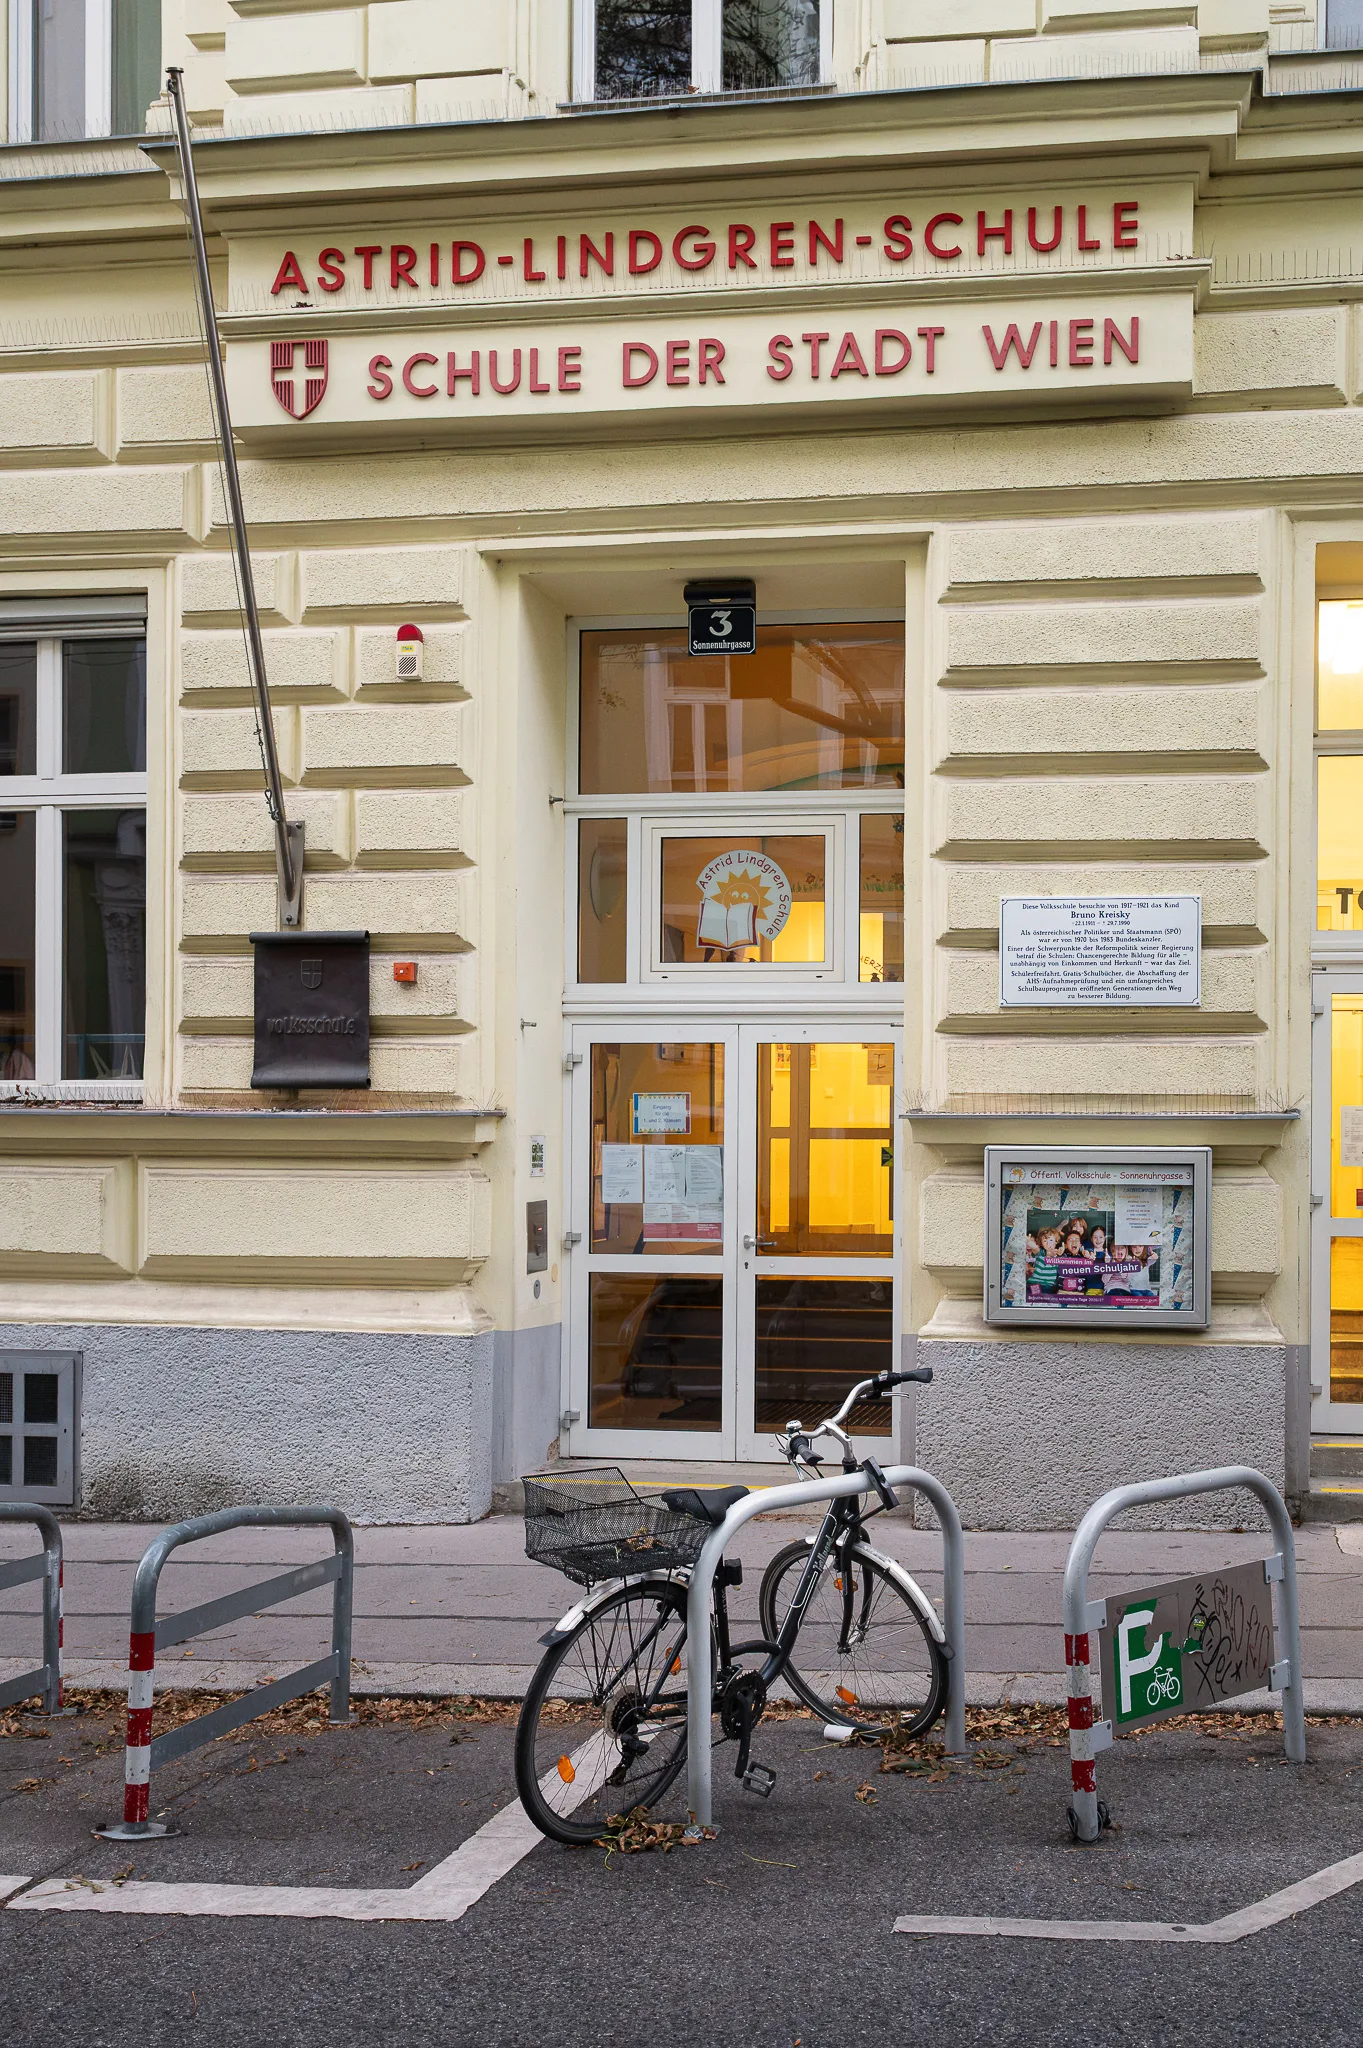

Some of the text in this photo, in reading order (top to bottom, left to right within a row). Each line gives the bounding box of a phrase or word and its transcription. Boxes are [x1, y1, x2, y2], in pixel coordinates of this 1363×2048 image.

[270, 201, 1139, 295] ASTRID-LINDGREN-SCHULE
[367, 316, 1139, 400] SCHULE DER STADT WIEN
[709, 611, 733, 636] 3
[693, 640, 750, 650] Sonnenuhrgasse
[699, 852, 790, 936] Astrid Lindgren Schule
[1336, 888, 1363, 914] T
[1099, 910, 1130, 919] Kreisky
[1164, 928, 1181, 936] (SPÖ)
[1030, 1170, 1063, 1179] Öffentl.
[1120, 1172, 1183, 1181] Sonnenuhrgasse
[1062, 1264, 1138, 1275] neuen Schuljahr
[1118, 1610, 1162, 1714] P
